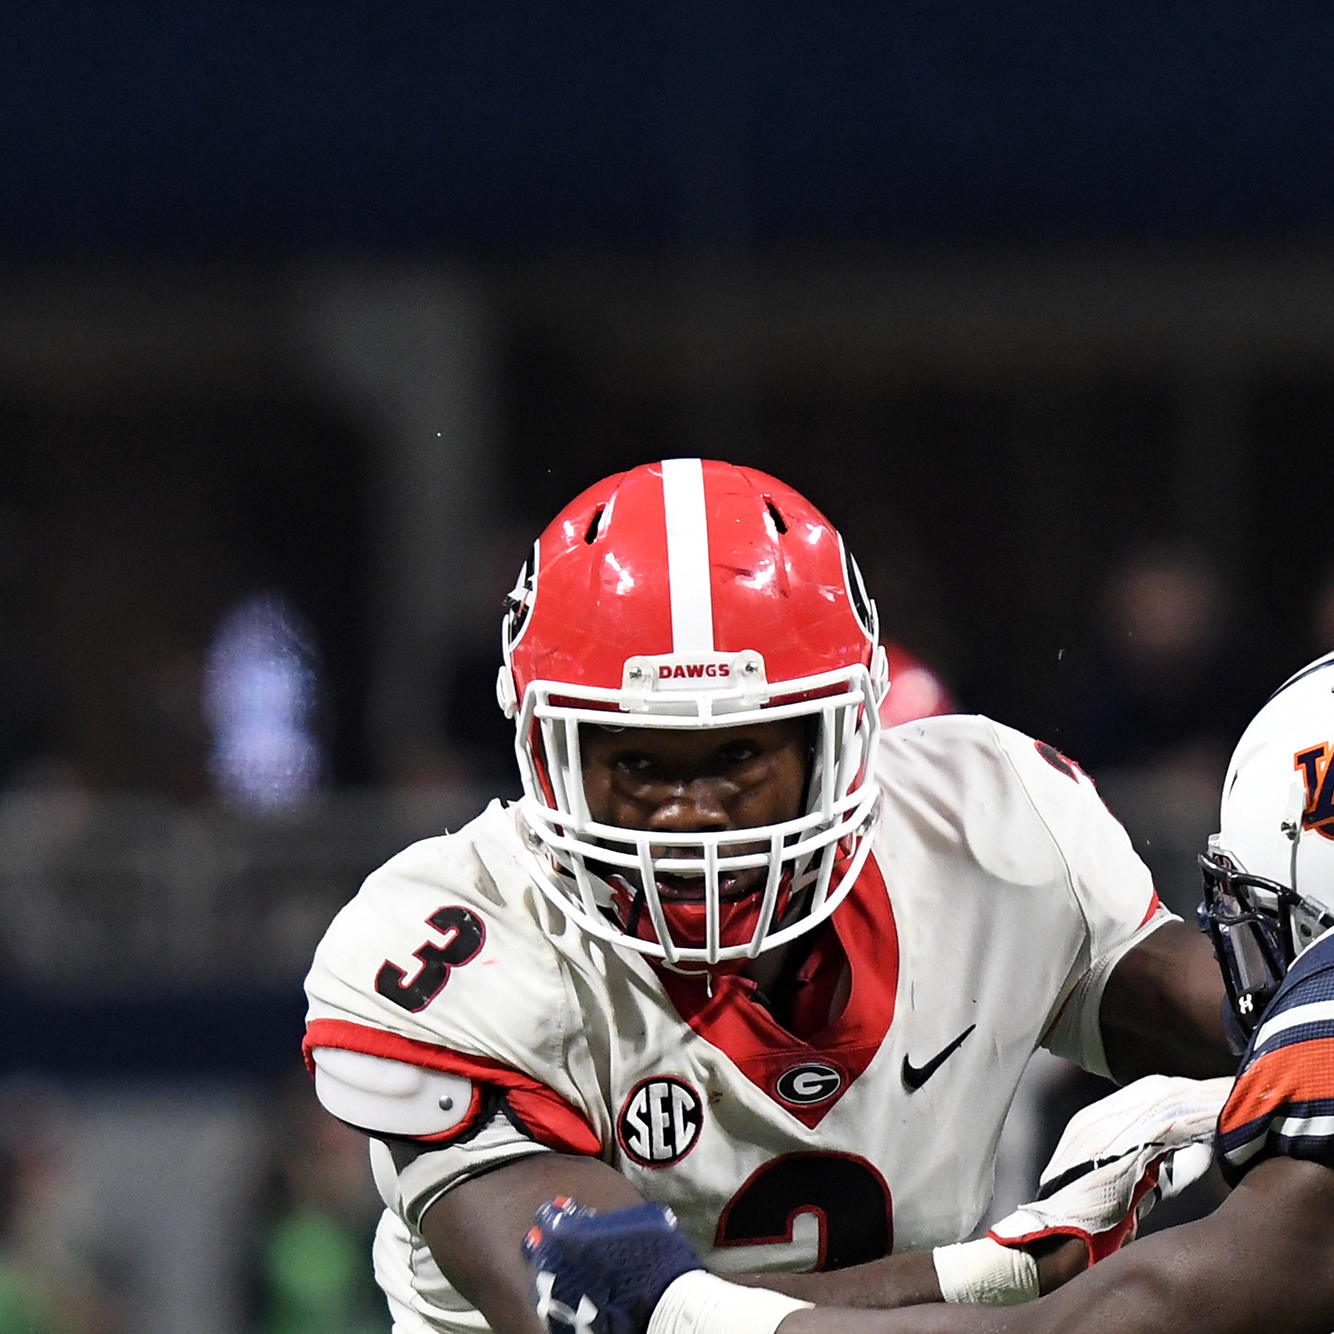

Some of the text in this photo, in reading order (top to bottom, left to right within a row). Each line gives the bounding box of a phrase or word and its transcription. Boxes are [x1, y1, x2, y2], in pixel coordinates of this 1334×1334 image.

[659, 664, 730, 679] DAWGS
[374, 905, 487, 1013] 3
[777, 1063, 841, 1104] G
[624, 1080, 703, 1162] SEC
